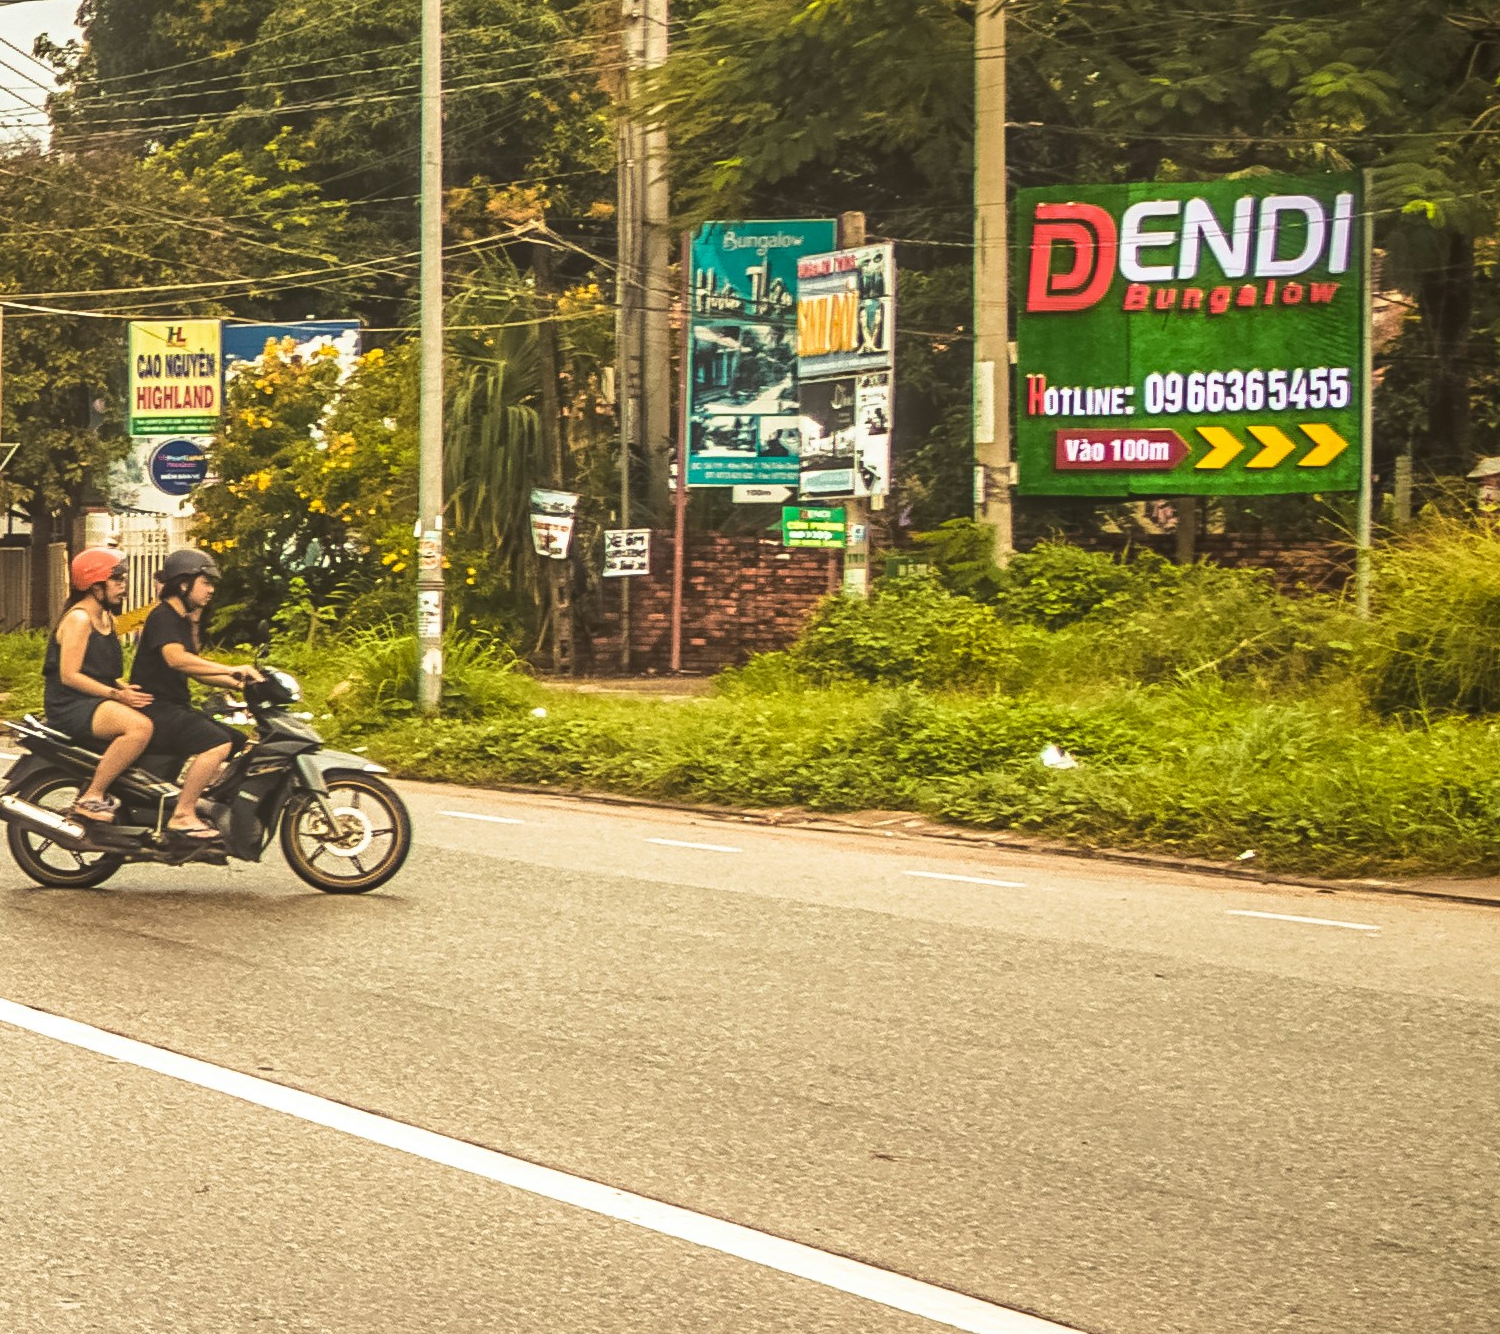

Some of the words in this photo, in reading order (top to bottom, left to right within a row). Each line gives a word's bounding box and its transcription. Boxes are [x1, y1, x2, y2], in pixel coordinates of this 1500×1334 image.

[723, 231, 804, 256] Bungalow
[1026, 192, 1354, 312] DENDI
[1123, 279, 1339, 314] Bungalow
[137, 354, 162, 379] CAO
[165, 348, 216, 378] NGUYÊN
[136, 384, 214, 410] HIGHLAND
[1145, 366, 1350, 414] 0966365455
[1064, 438, 1104, 462] Vào
[1110, 439, 1170, 461] 100m
